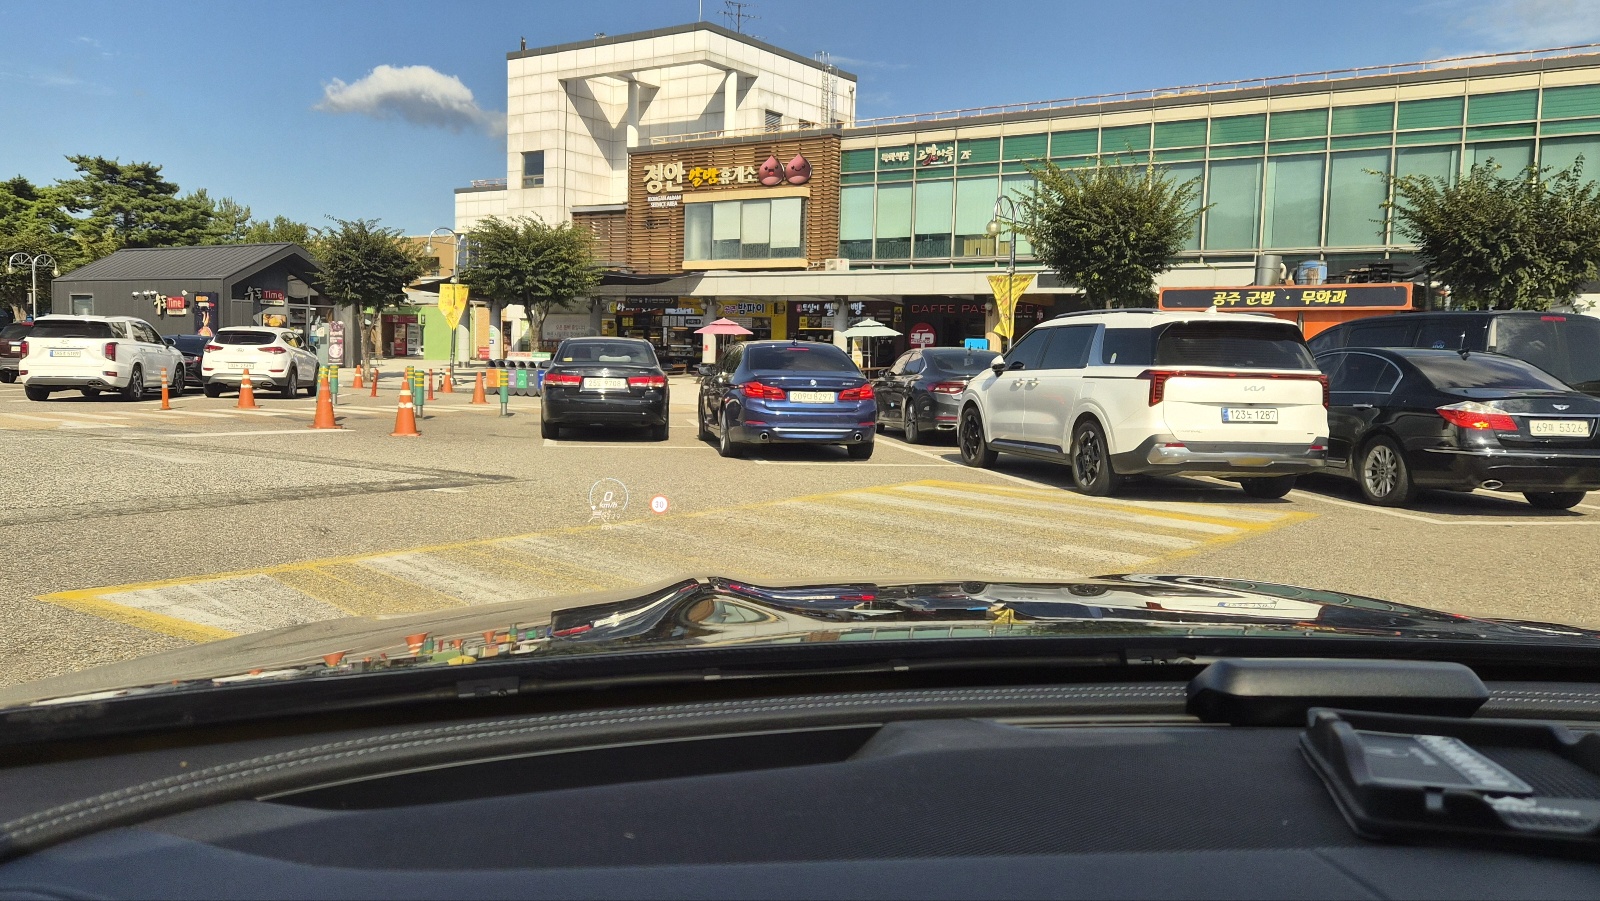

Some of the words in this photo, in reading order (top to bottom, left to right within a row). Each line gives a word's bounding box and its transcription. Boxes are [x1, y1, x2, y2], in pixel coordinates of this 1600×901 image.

[643, 161, 686, 194] 정안
[718, 166, 758, 185] 휴게소
[264, 290, 283, 300] Time
[1212, 291, 1241, 306] 공주
[1245, 291, 1276, 306] 군밤
[1301, 290, 1348, 305] 무화과
[167, 297, 182, 309] Time
[738, 302, 765, 315] 밤파이
[911, 304, 956, 314] CAFFE
[814, 392, 832, 401] 8297
[1255, 410, 1276, 420] 1287
[1559, 423, 1584, 433] 5326
[603, 491, 613, 502] 0
[654, 501, 665, 509] 30
